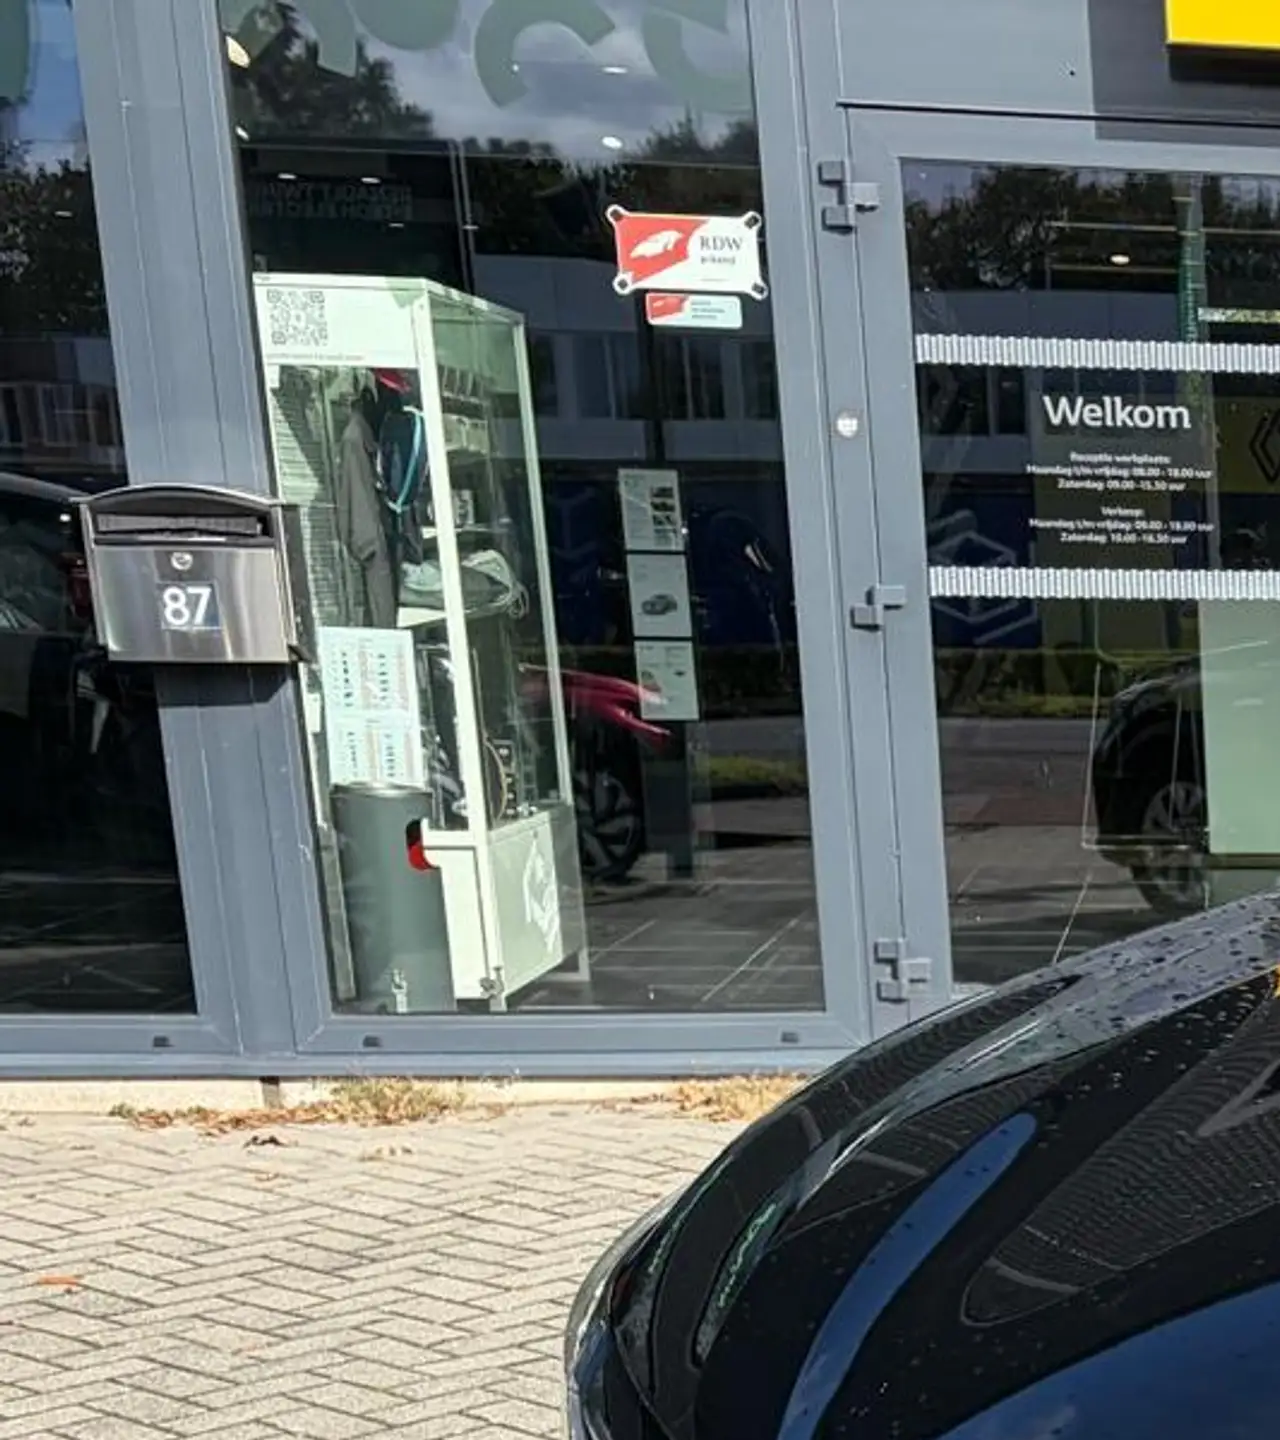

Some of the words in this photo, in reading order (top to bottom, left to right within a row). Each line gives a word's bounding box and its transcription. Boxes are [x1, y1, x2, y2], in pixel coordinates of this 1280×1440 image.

[699, 235, 743, 251] RDW
[1042, 395, 1192, 429] Welkom
[1026, 464, 1072, 477] Maandag
[1028, 518, 1075, 531] Maandag
[163, 586, 212, 625] 87
